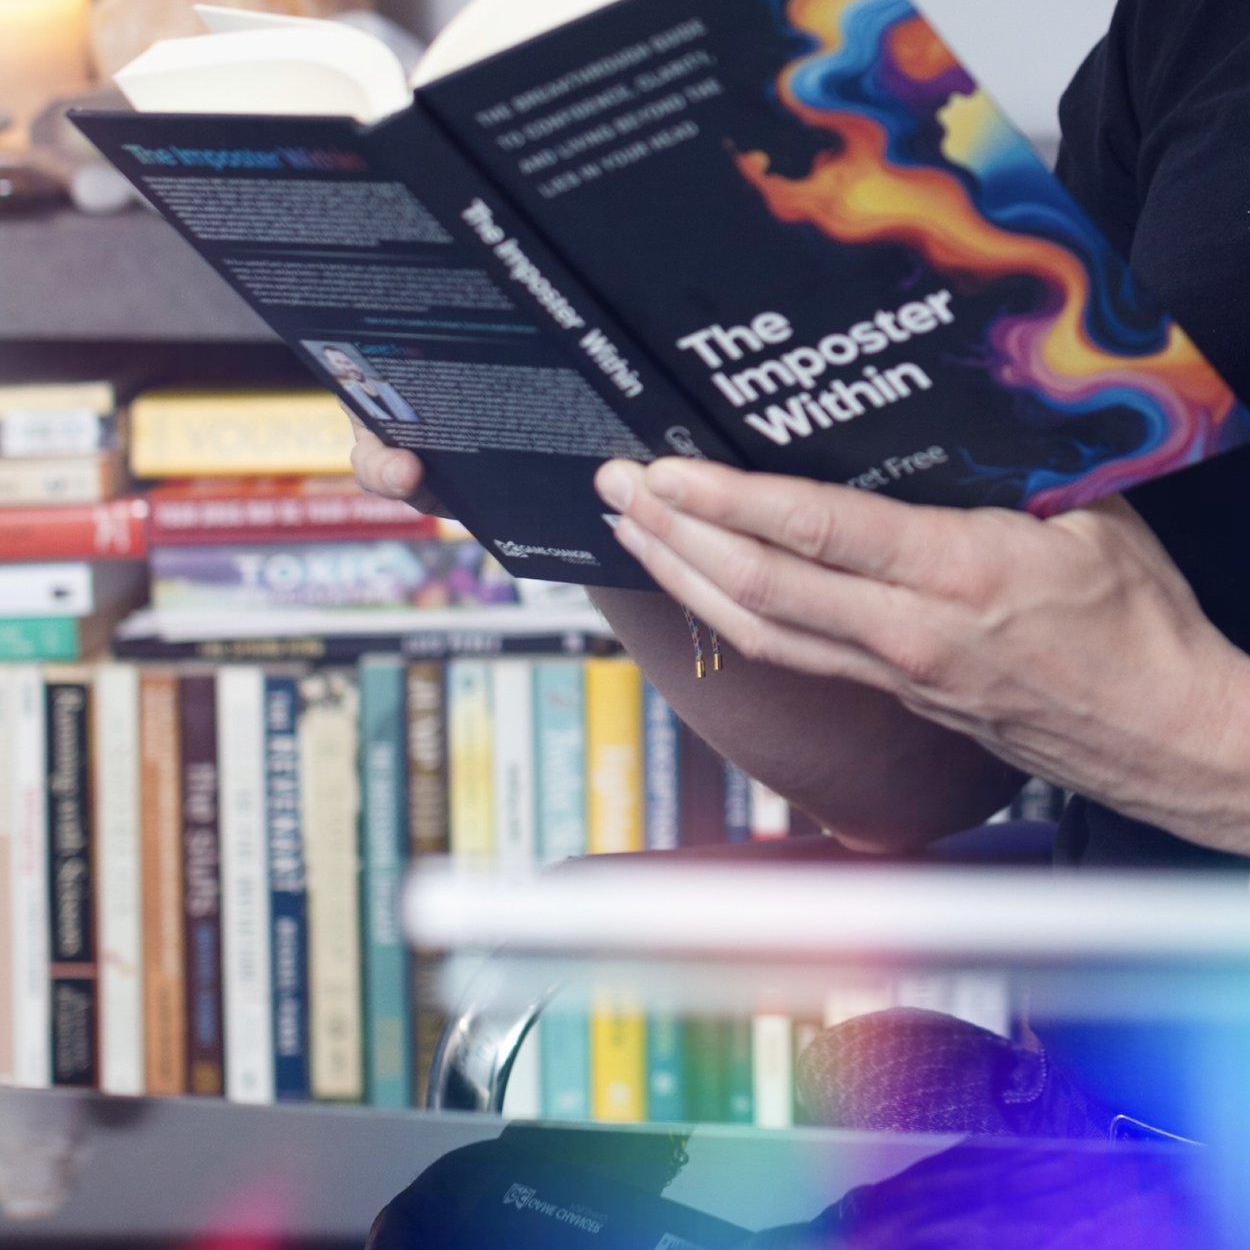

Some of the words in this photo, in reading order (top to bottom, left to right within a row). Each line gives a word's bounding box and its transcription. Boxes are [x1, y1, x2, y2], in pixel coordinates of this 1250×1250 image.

[462, 198, 504, 244] The
[494, 238, 585, 329] Imposter
[580, 328, 644, 398] Within
[677, 311, 793, 368] The
[711, 289, 955, 407] Imposter
[744, 362, 933, 446] Within
[884, 446, 948, 480] Free
